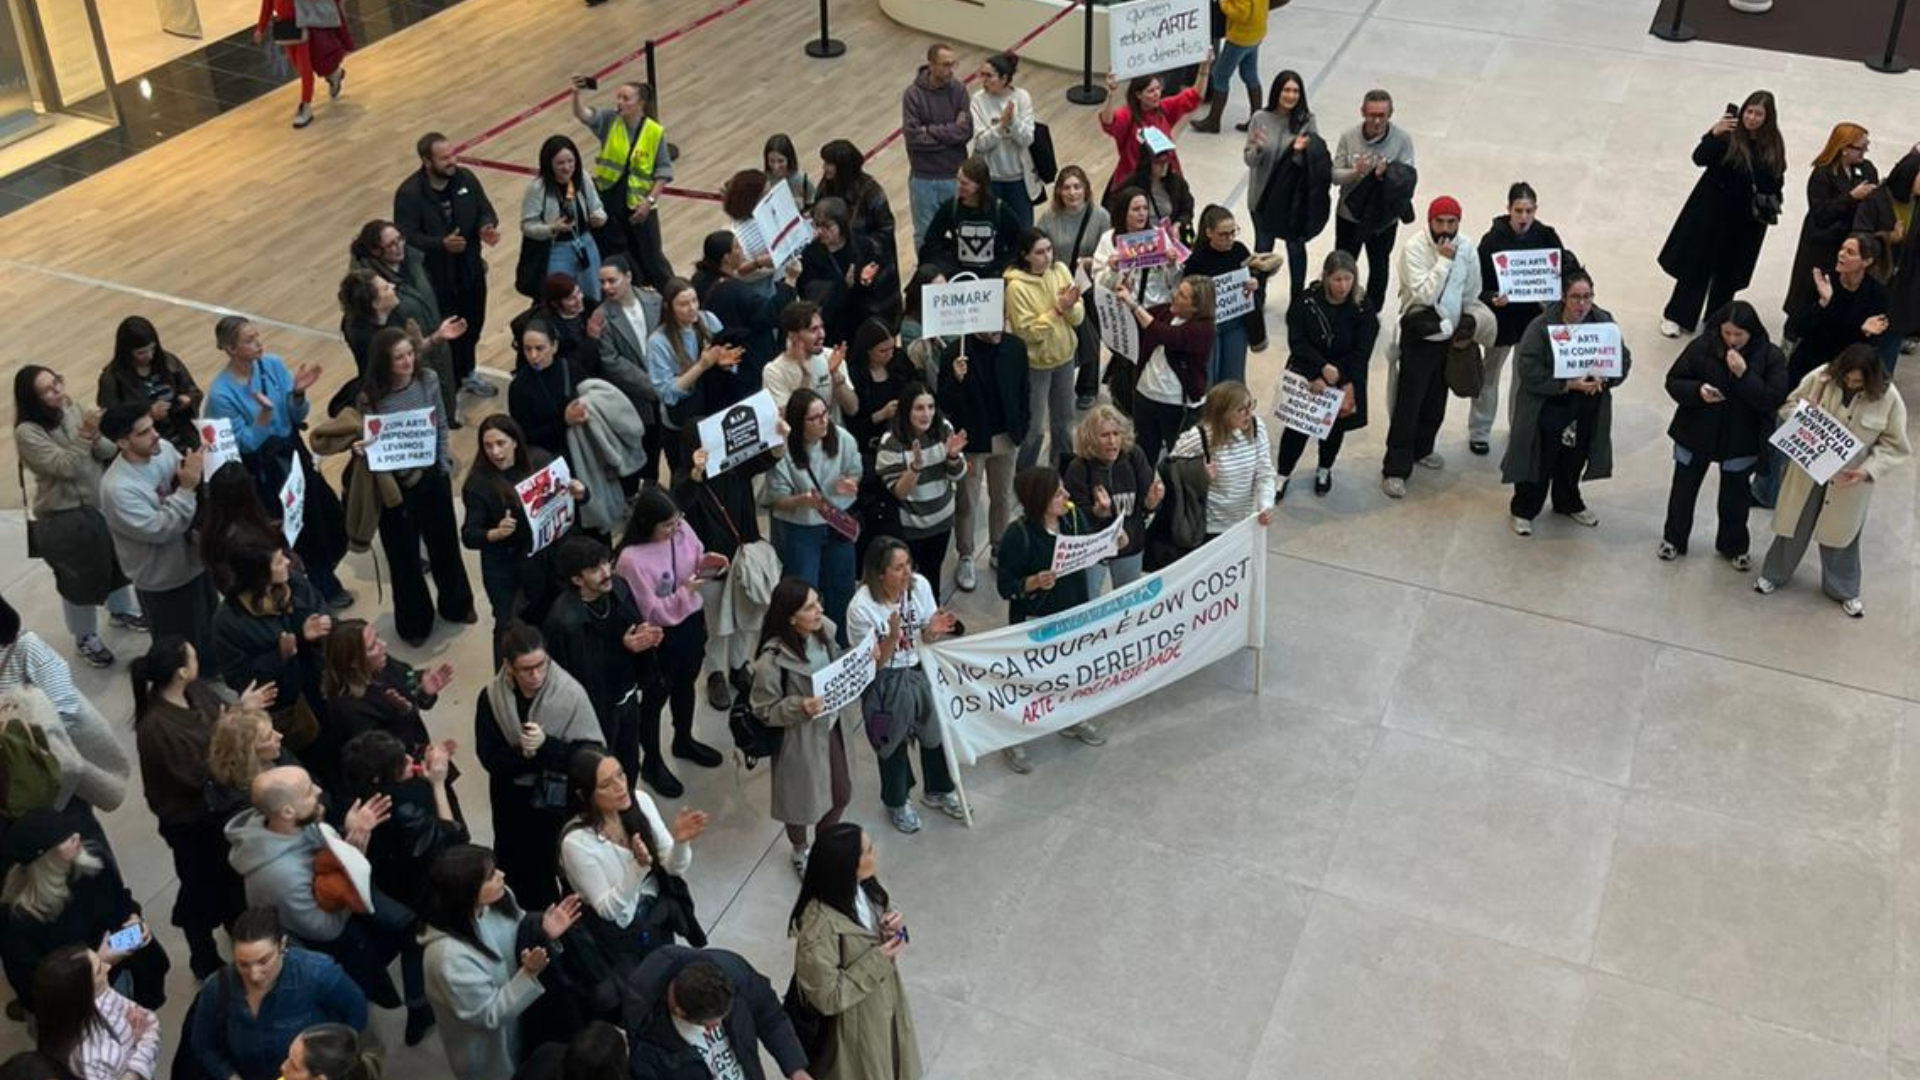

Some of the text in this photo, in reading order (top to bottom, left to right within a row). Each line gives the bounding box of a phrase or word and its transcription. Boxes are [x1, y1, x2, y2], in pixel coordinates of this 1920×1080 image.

[933, 290, 992, 308] PRIMARK
[1571, 346, 1616, 356] COMPARTE
[1577, 333, 1599, 343] ARTE
[1579, 358, 1613, 369] REPARTE
[1280, 403, 1320, 425] CONVENIO
[1804, 405, 1855, 449] CONVENIO
[1793, 411, 1849, 462] PROVINCIAL
[1798, 427, 1827, 453] NON O
[937, 667, 949, 687] A
[1024, 628, 1108, 673] ROUPA
[1116, 609, 1133, 635] É
[1136, 590, 1185, 626] LOW
[1191, 556, 1251, 602] COST
[951, 695, 981, 720] OS
[987, 674, 1070, 711] NOSOS
[1076, 622, 1186, 687] DEREITOS
[1191, 591, 1240, 631] NON
[1022, 693, 1055, 725] ARTE
